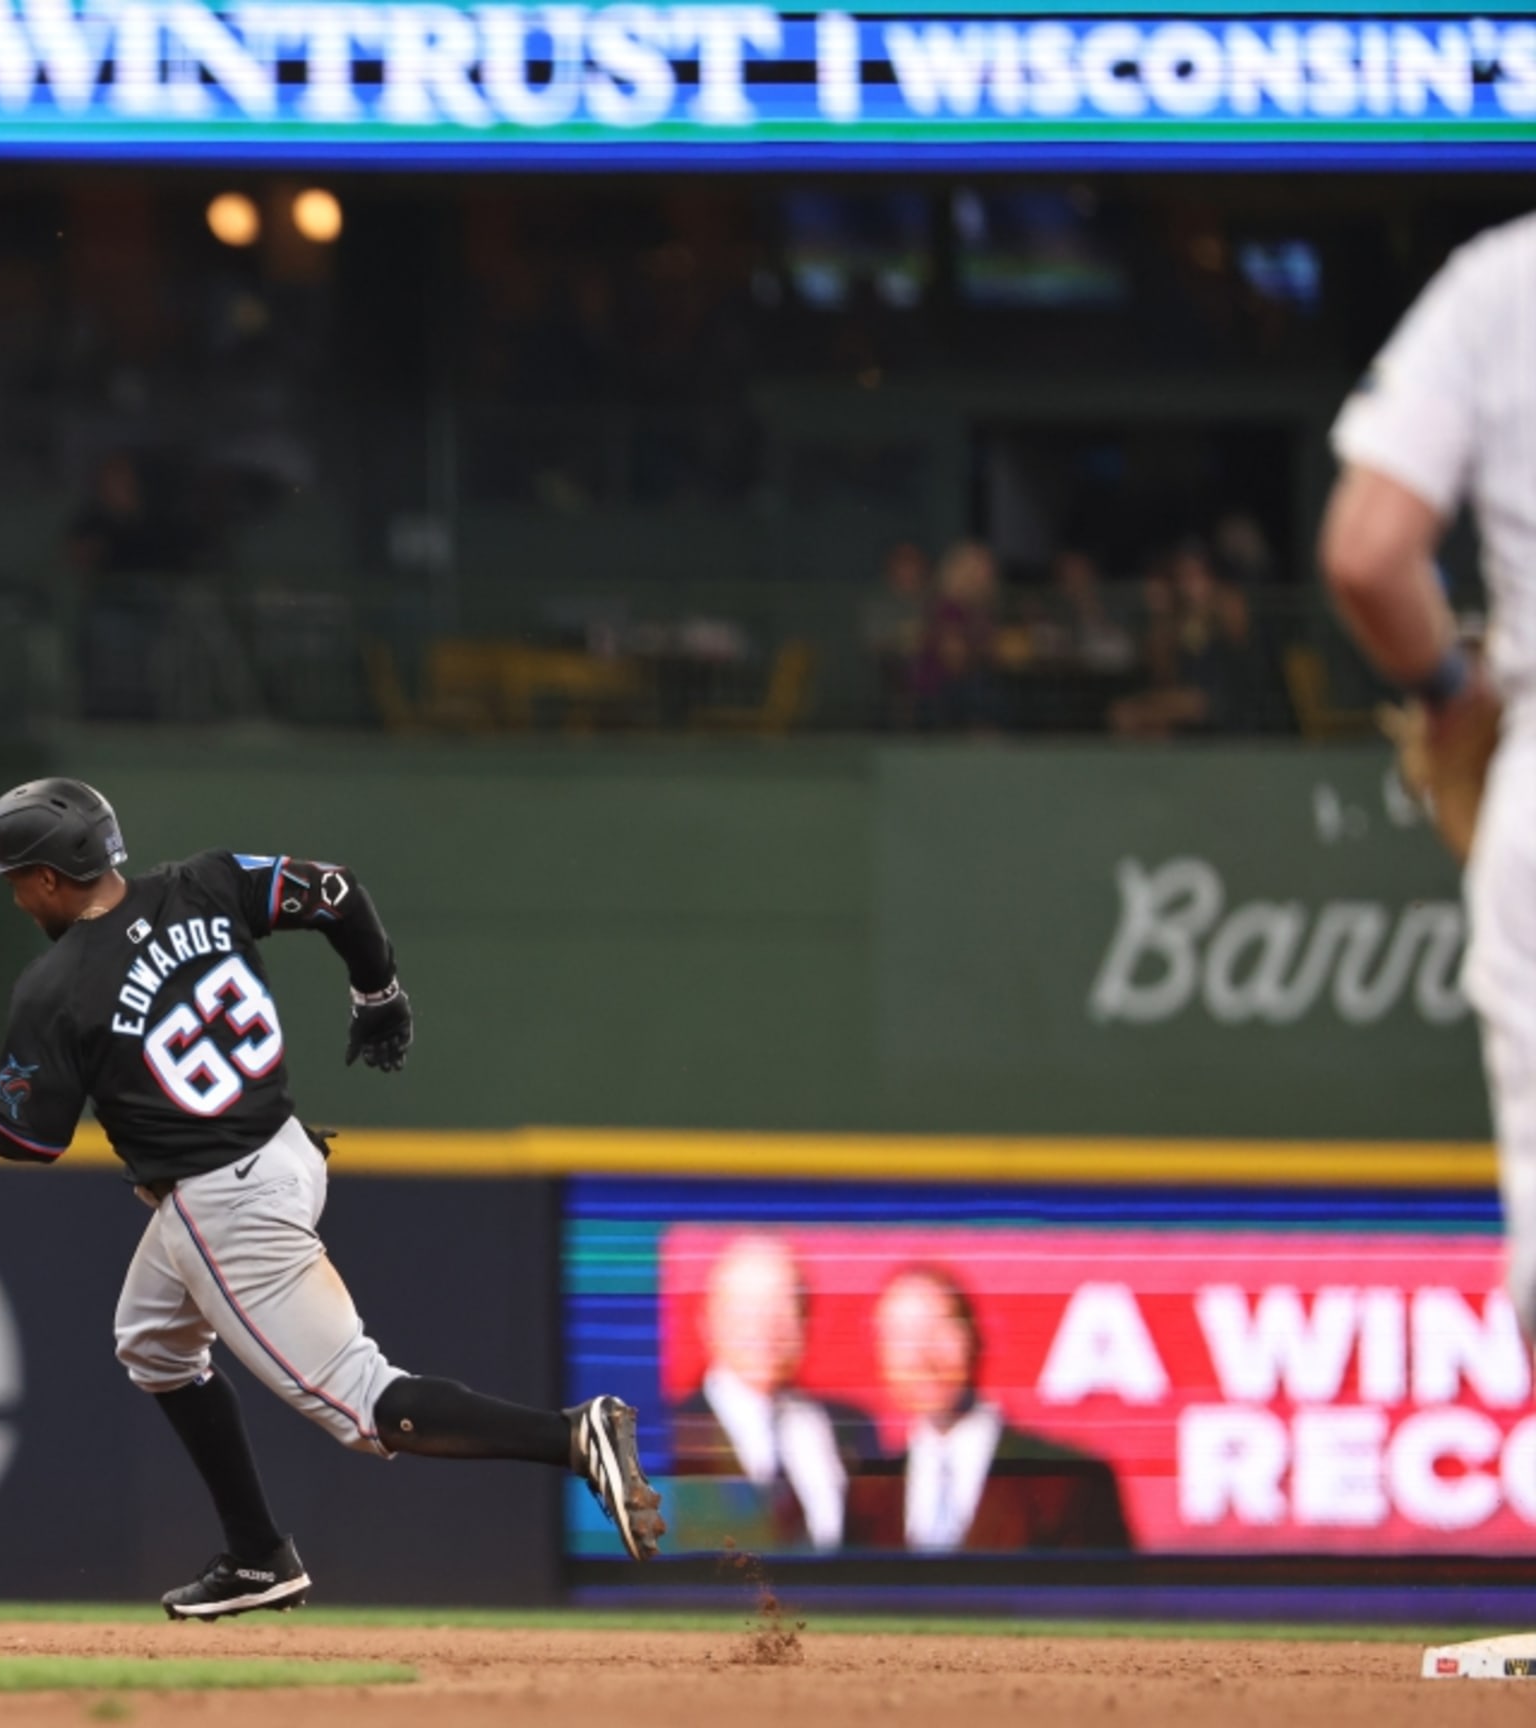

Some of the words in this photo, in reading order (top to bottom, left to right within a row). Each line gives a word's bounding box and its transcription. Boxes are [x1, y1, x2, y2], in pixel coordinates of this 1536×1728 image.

[884, 18, 1536, 117] WISCONSIN'S
[112, 916, 232, 1036] EDWARDS
[143, 953, 285, 1117] 63
[1036, 1282, 1172, 1406] A
[1193, 1283, 1532, 1408] WIN
